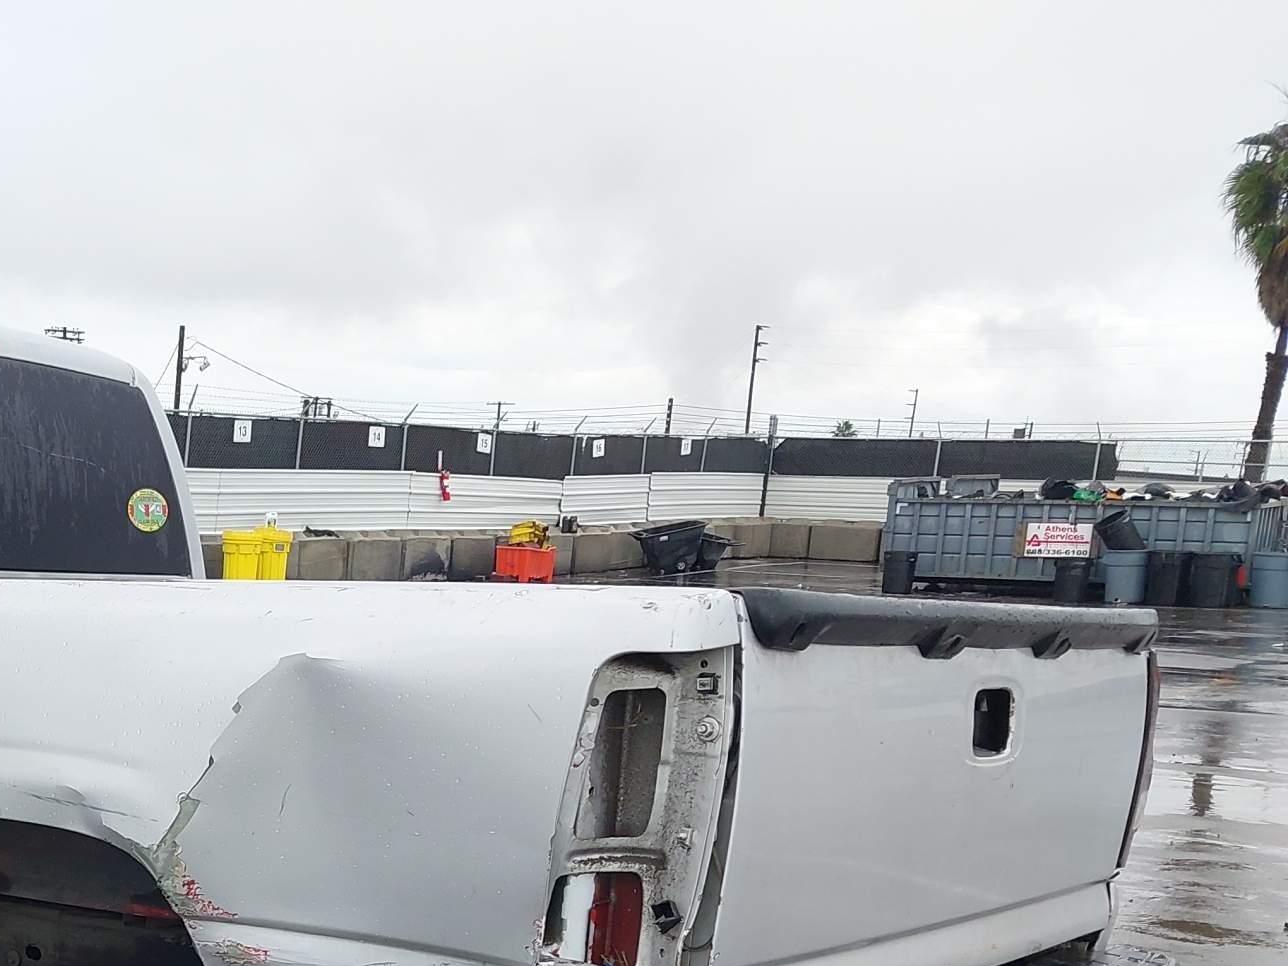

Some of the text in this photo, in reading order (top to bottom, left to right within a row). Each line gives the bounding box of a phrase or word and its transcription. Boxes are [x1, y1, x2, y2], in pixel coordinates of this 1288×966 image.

[238, 425, 247, 437] 13
[1044, 525, 1078, 533] Athens
[1044, 532, 1085, 541] Services
